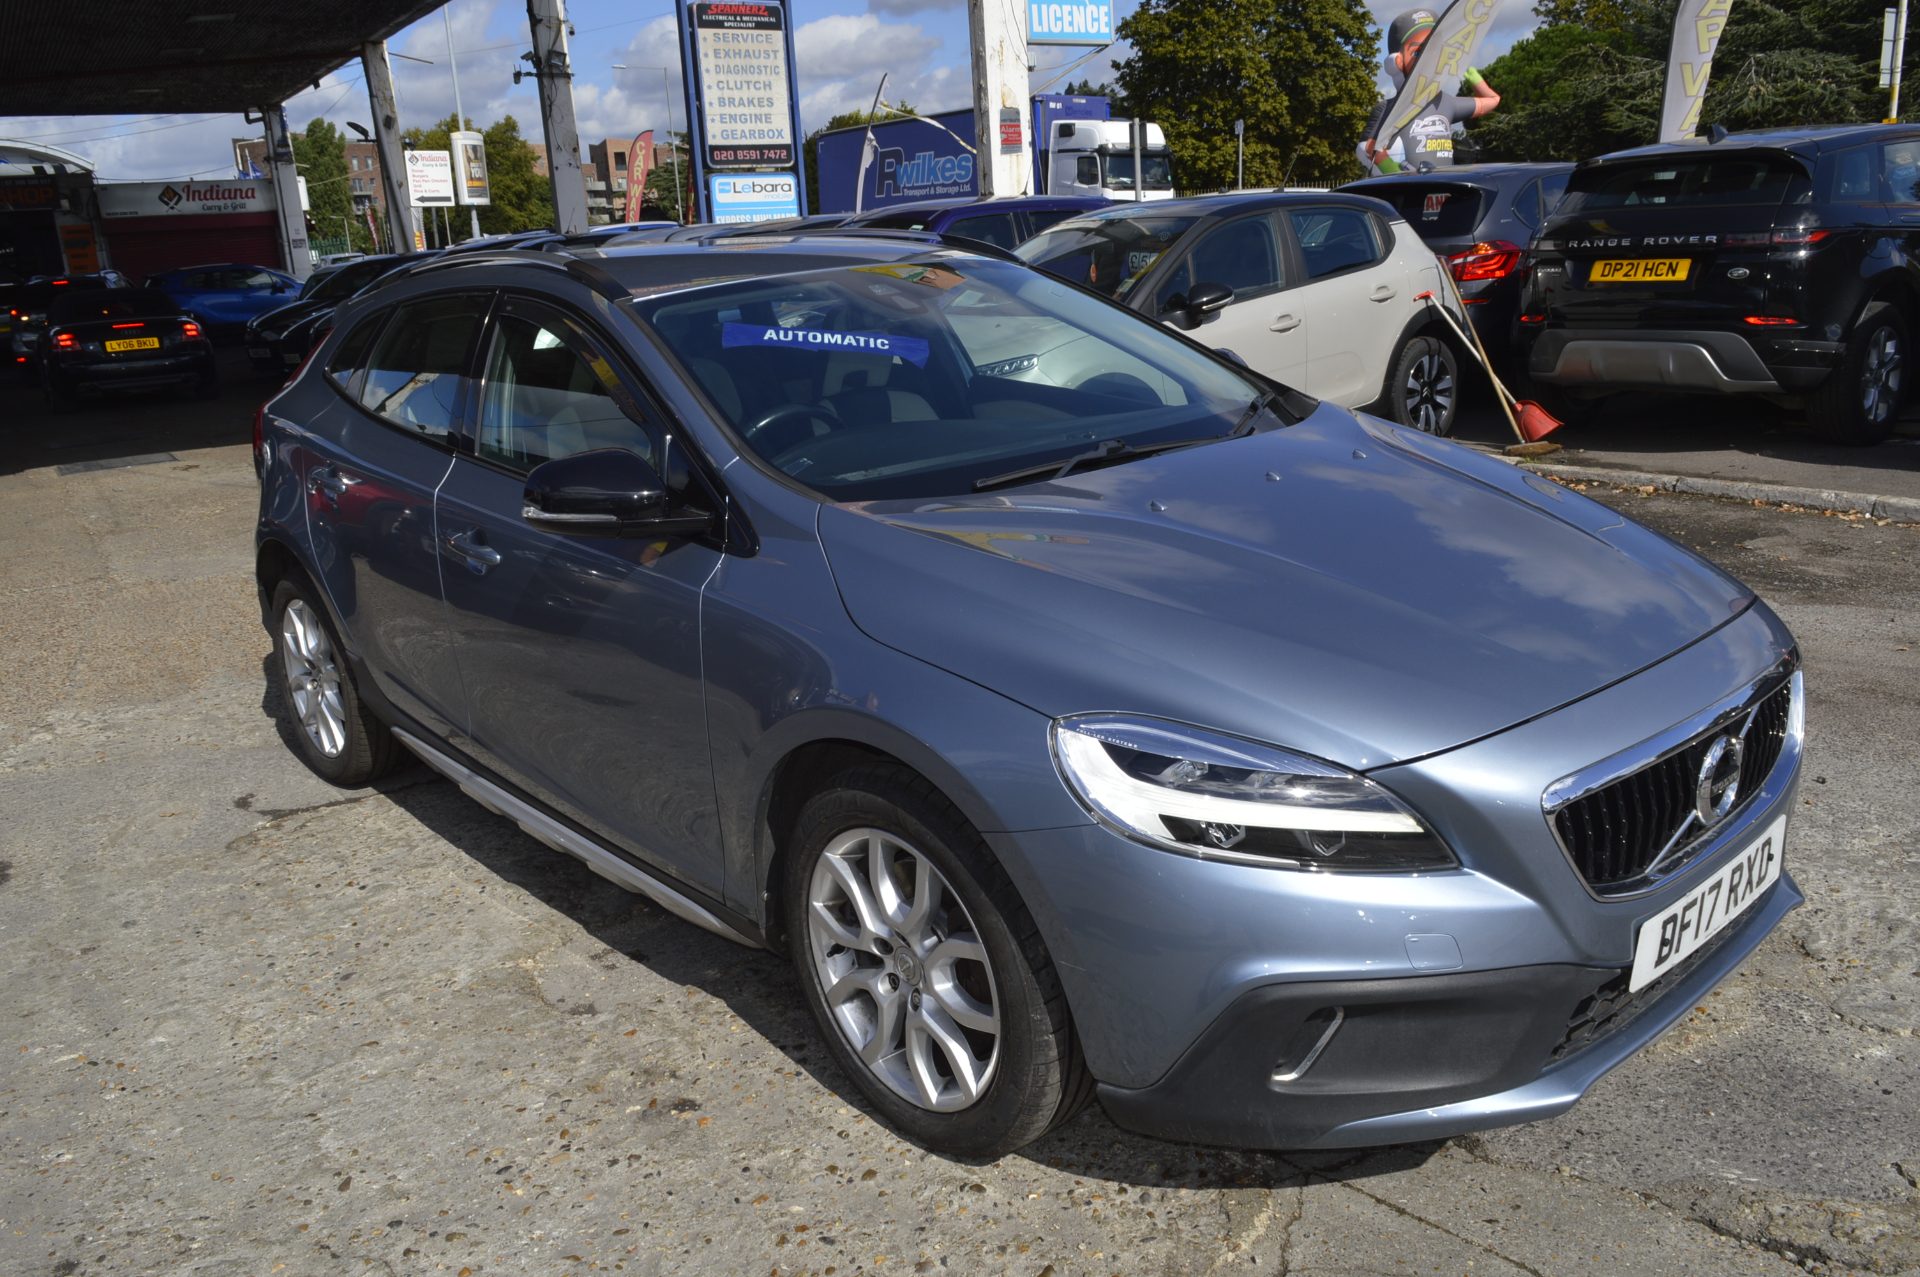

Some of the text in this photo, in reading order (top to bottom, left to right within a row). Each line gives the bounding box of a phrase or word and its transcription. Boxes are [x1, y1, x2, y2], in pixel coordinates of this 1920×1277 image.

[708, 4, 768, 16] SPANNERZ
[1031, 4, 1110, 33] LICENCE
[713, 32, 773, 44] SERVICE
[713, 48, 779, 60] EXHAUST
[714, 64, 780, 76] DIAGNOSTIC
[716, 80, 772, 91] CLUTCH
[718, 97, 774, 108] BRAKES
[719, 113, 772, 124] ENGINE
[721, 129, 785, 140] GEARBOX
[1001, 125, 1021, 133] Alarm
[1416, 135, 1427, 153] 2
[418, 154, 448, 162] Indiana
[633, 140, 645, 180] CAR
[714, 150, 787, 160] 020 8591 7472
[182, 184, 256, 202] Indiana
[733, 181, 792, 193] Lebara
[904, 184, 972, 197] Transport & Storage Ltd.
[202, 203, 222, 212] Curry
[1568, 235, 1718, 248] RANGE ROVER
[1600, 262, 1680, 278] DP21 HCN
[110, 338, 155, 350] LY06 BKU
[763, 329, 890, 350] AUTOMATIC
[1725, 836, 1773, 916] RXD
